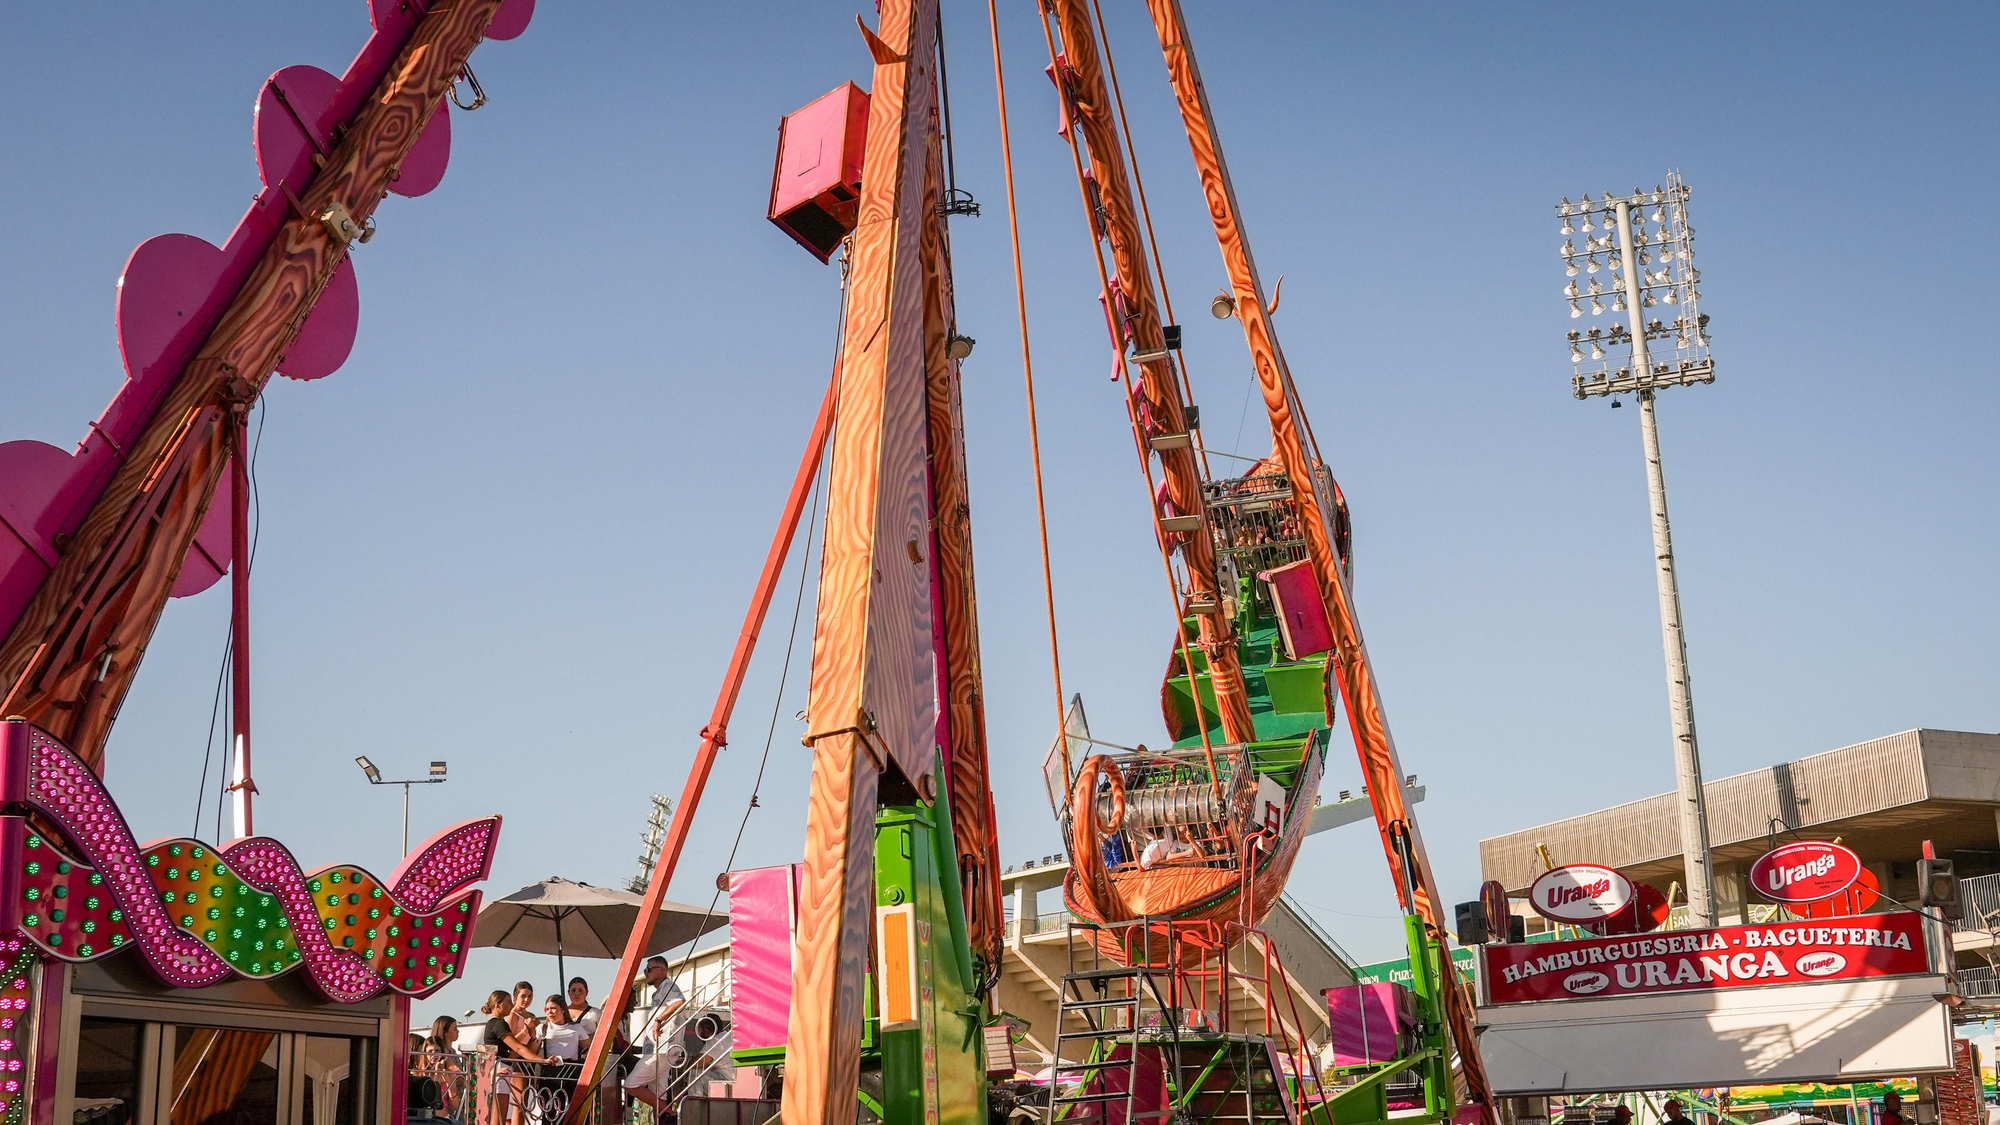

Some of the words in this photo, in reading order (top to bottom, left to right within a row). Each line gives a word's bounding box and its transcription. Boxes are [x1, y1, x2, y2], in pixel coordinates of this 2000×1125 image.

[1768, 854, 1836, 891] Uranga
[1547, 878, 1611, 909] Uranga
[1502, 932, 1729, 984] HAMBURGUESERIA
[1744, 928, 1912, 951] BAGUETERIA
[1613, 950, 1789, 989] URANGA
[1802, 957, 1835, 972] Uranga
[1569, 975, 1600, 990] Uranga
